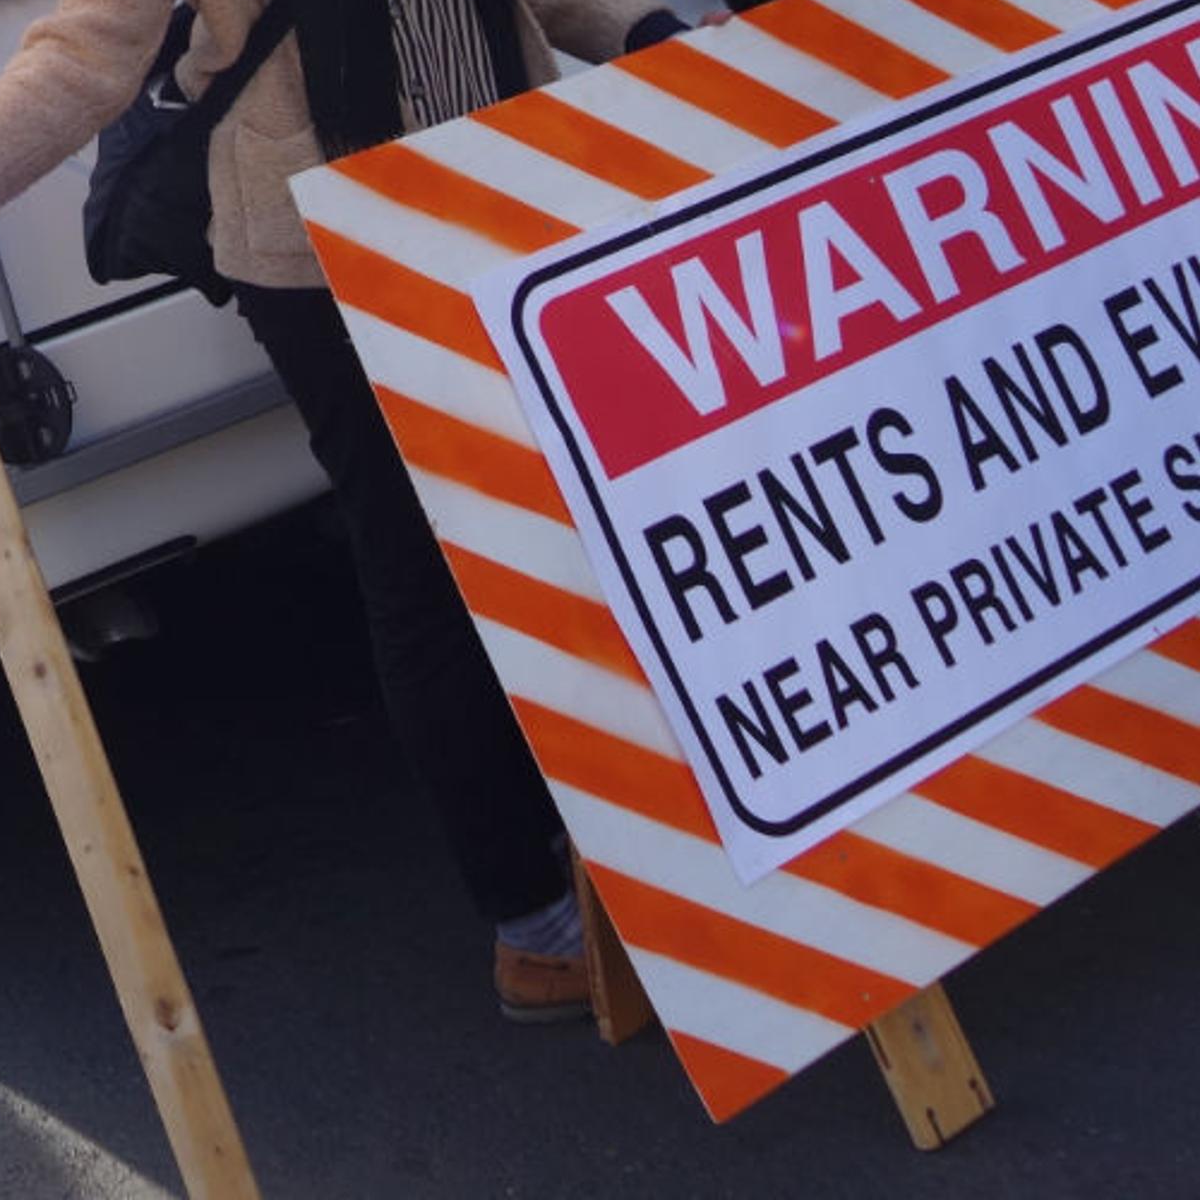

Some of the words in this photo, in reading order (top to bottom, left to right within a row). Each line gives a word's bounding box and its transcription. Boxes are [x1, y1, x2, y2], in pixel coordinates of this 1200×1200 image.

[643, 407, 944, 643] RENTS
[944, 323, 1111, 492] AND
[1103, 256, 1200, 399] EV
[715, 612, 920, 781] NEAR
[910, 469, 1172, 669] PRIVATE
